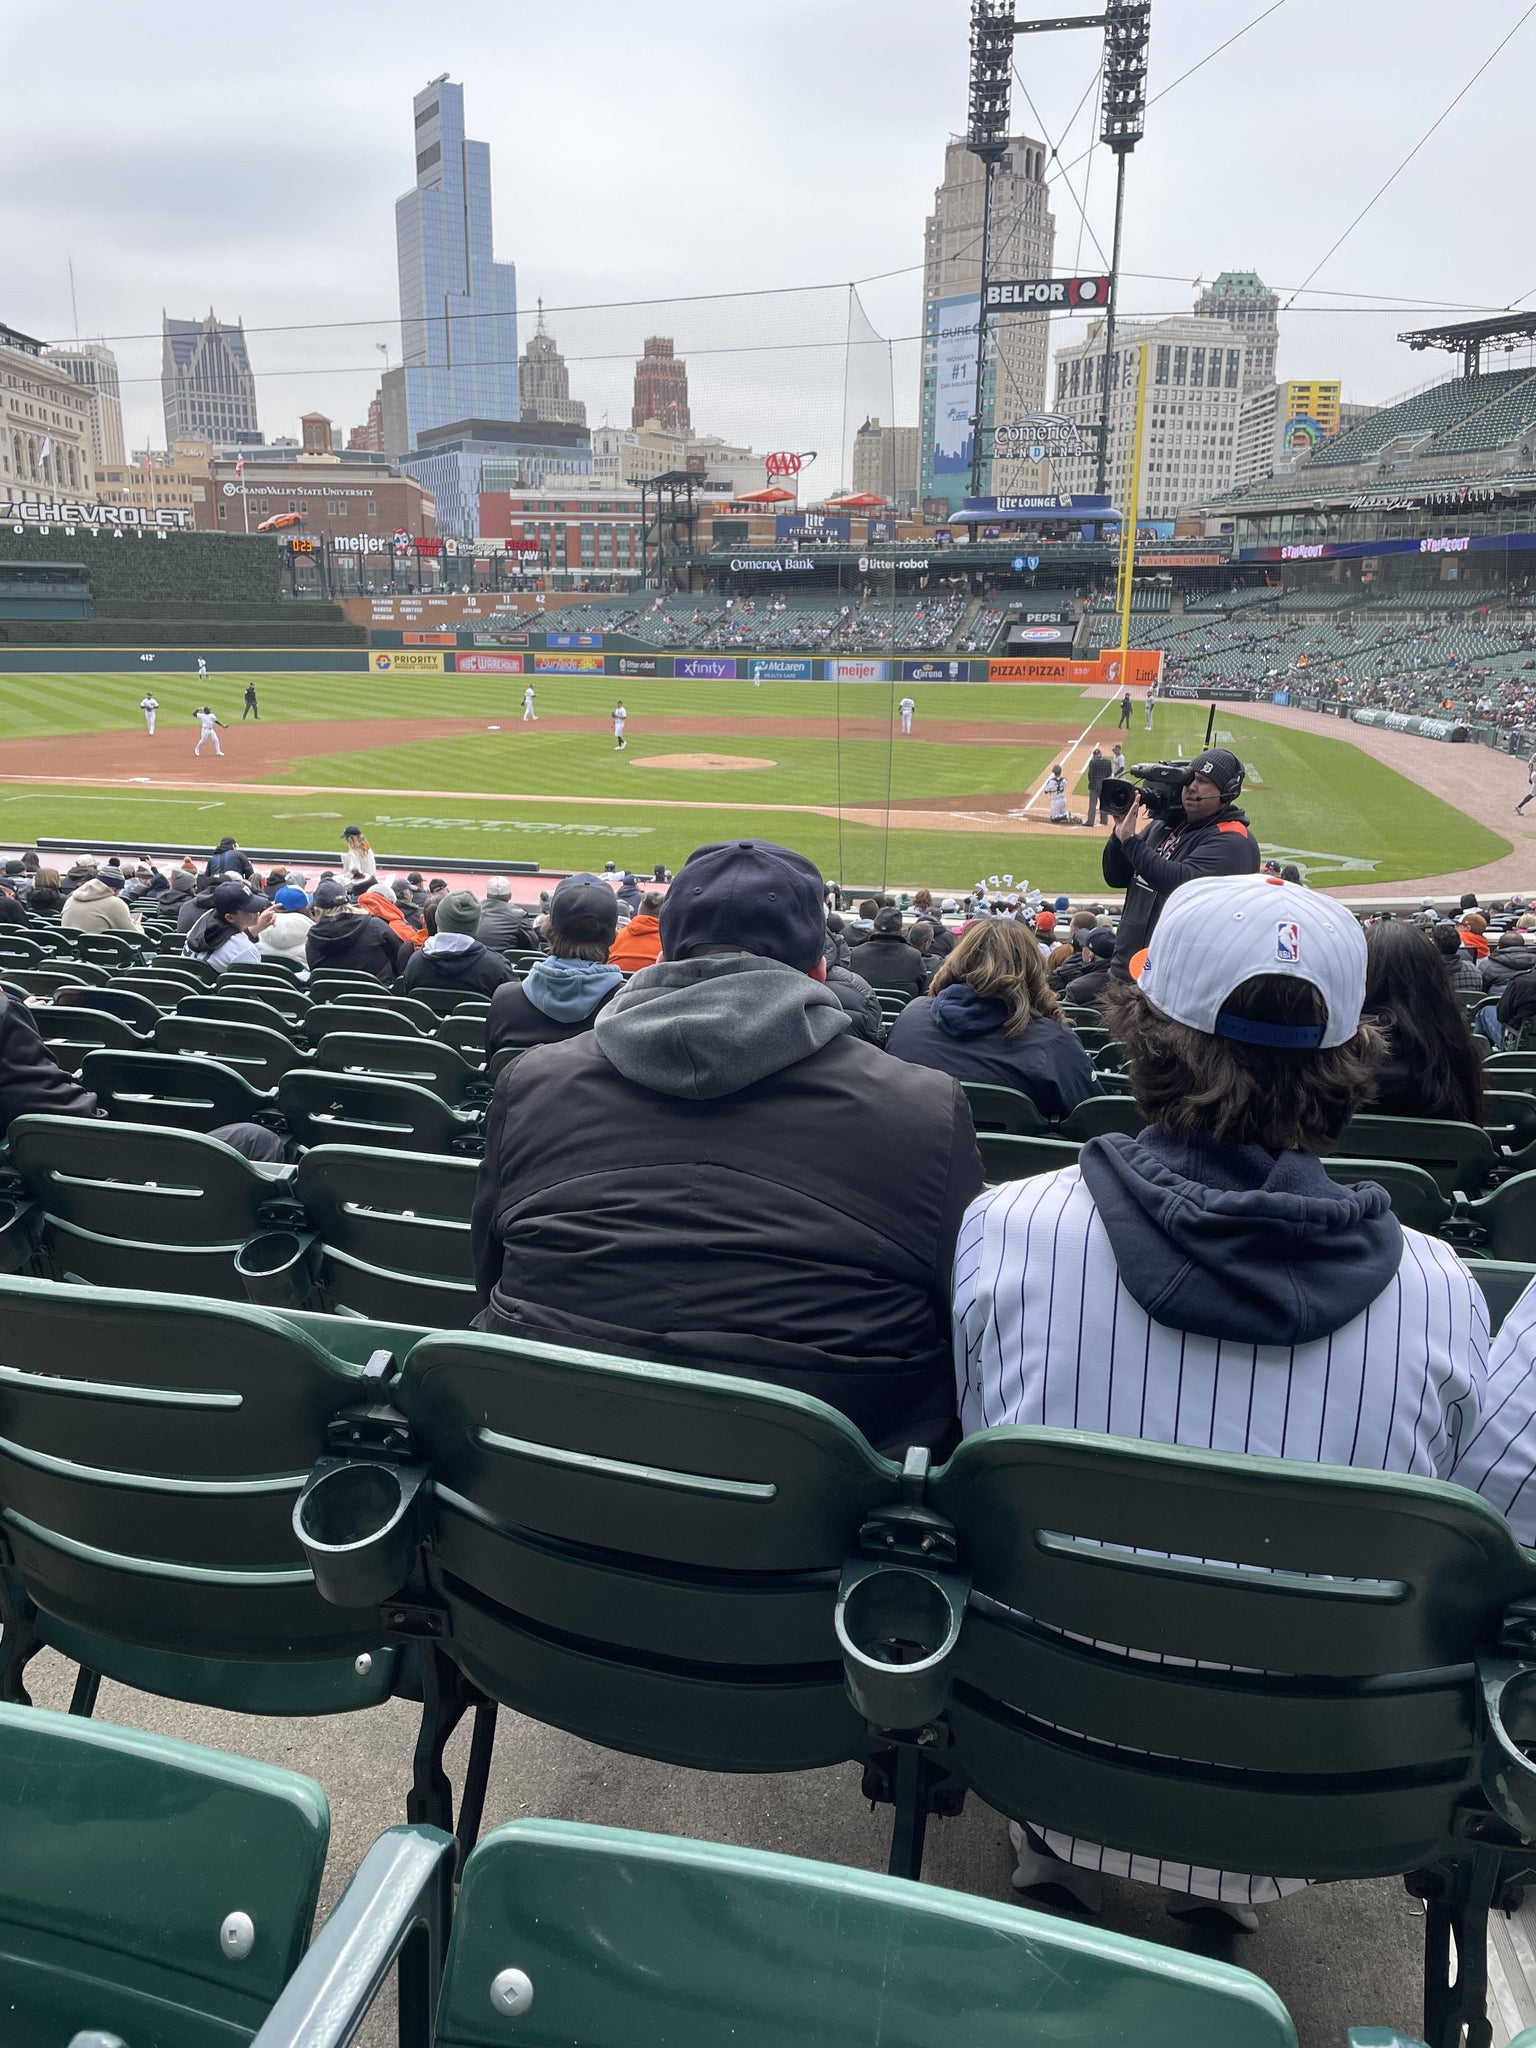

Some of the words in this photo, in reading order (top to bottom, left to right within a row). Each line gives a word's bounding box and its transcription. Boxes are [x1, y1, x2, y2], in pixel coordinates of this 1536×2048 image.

[986, 284, 1064, 304] BELFOR
[952, 363, 966, 379] #1
[993, 447, 1082, 458] LANDING
[768, 452, 799, 475] AAA
[236, 486, 267, 495] GRAND
[266, 486, 297, 496] VALLEY
[297, 486, 323, 496] STATE
[323, 487, 374, 497] UNIVERSITY
[1468, 489, 1495, 502] CLUB
[996, 496, 1019, 512] Lite
[1018, 497, 1056, 508] LOUNGE
[19, 501, 190, 527] CHEVROLET
[804, 513, 825, 529] Lite
[334, 532, 385, 555] meijer
[413, 537, 443, 546] BELLE
[1419, 537, 1470, 553] STRIKEOUT
[418, 546, 439, 555] TIRE
[517, 550, 539, 560] LAW
[1281, 544, 1324, 559] STRIKEOUT
[784, 558, 815, 570] Bank
[467, 597, 477, 607] 10
[503, 595, 510, 604] 11
[535, 595, 546, 604] 42
[1026, 613, 1061, 623] PEPSI
[394, 655, 438, 664] PRIORITY
[459, 658, 477, 671] ABC
[477, 657, 520, 672] WAREHOUSE
[540, 657, 578, 670] Surfside
[684, 660, 726, 677] xfinity
[767, 661, 805, 672] McLaren
[838, 662, 876, 679] meijer
[990, 665, 1026, 677] PIZZA!
[1029, 665, 1065, 677] PIZZA!
[912, 668, 943, 680] Corona
[1136, 668, 1158, 681] Little
[375, 815, 657, 834] VICTORS
[1278, 950, 1293, 960] NBA
